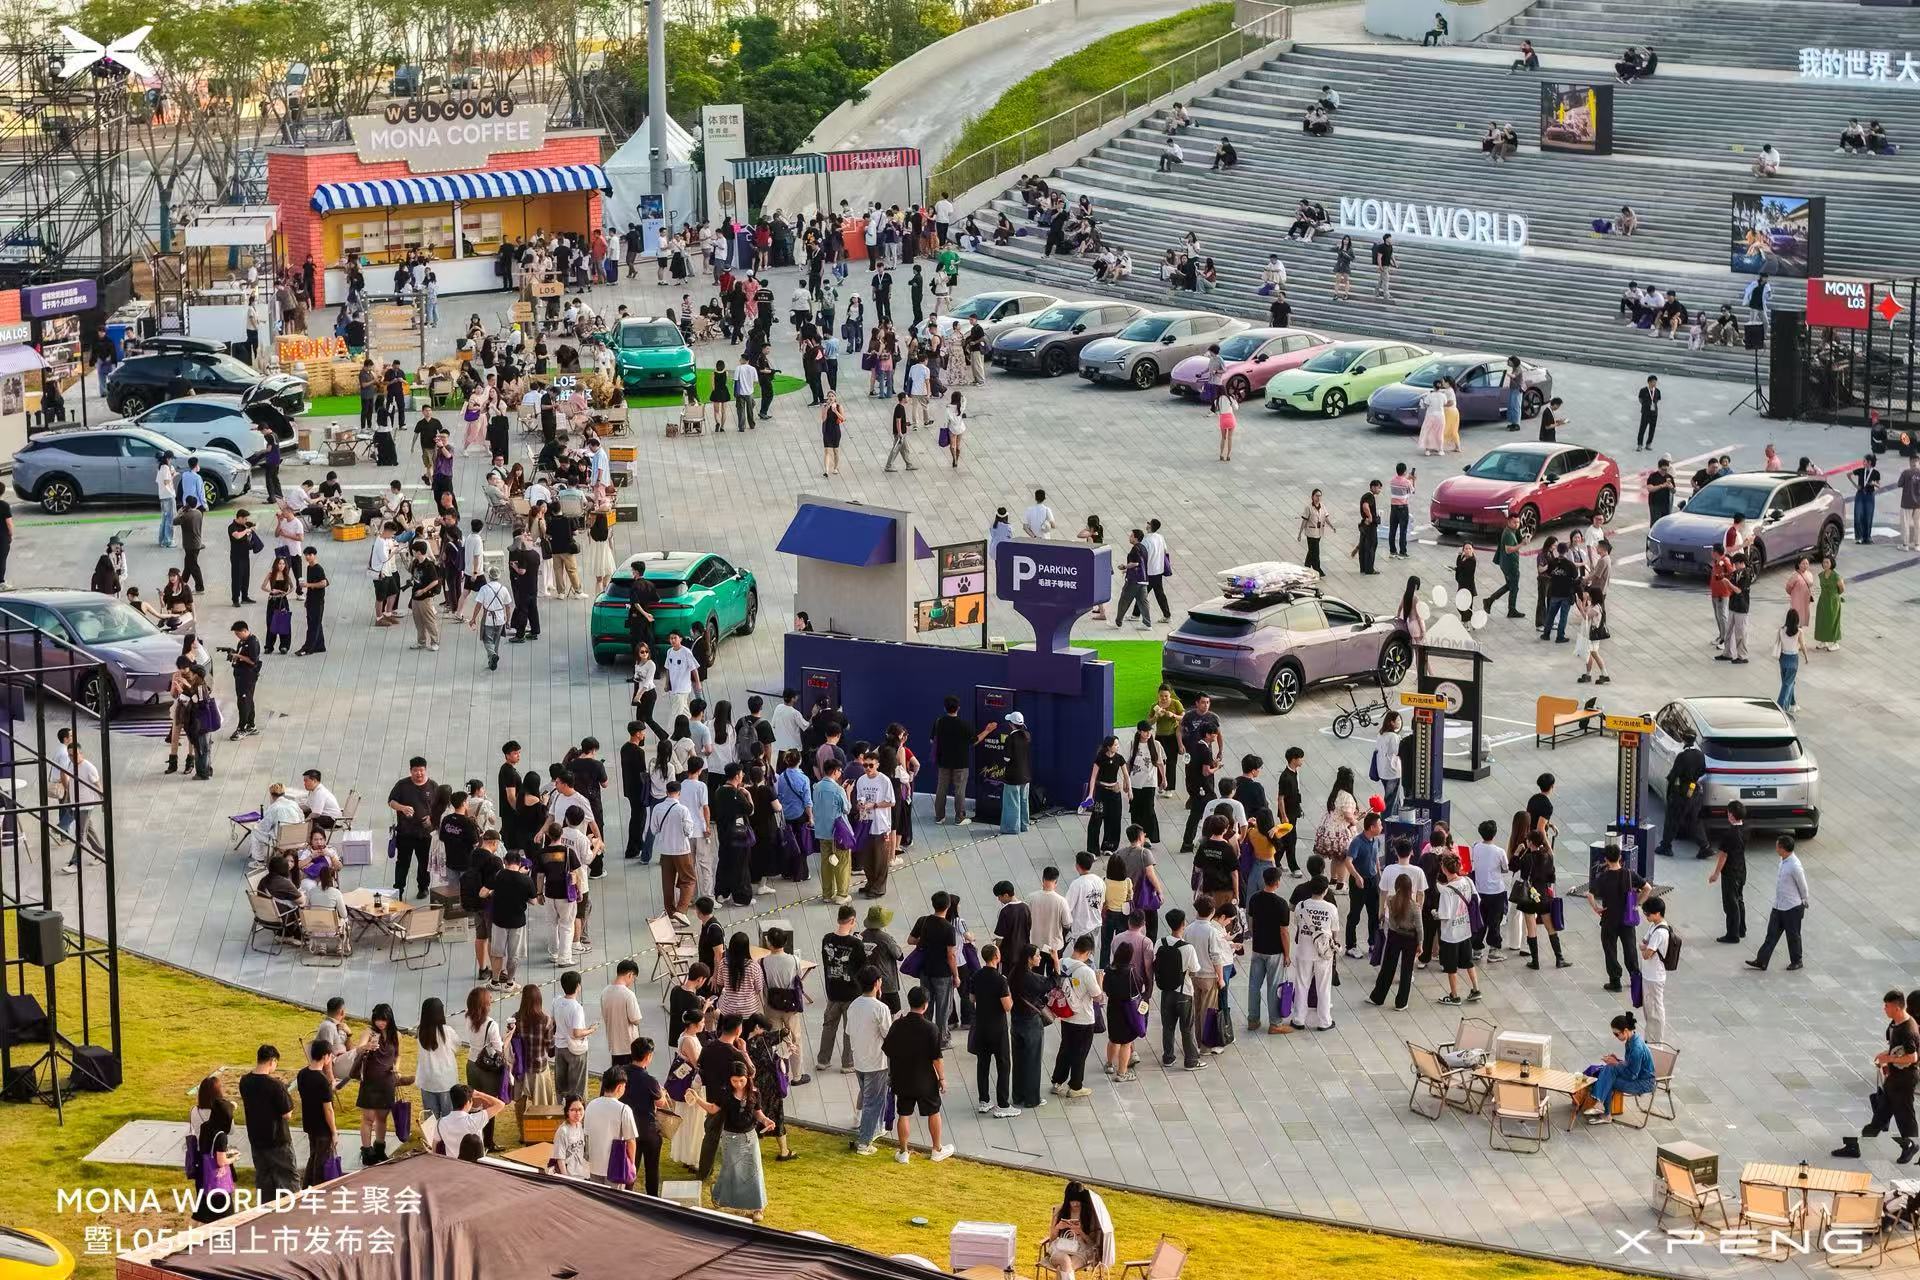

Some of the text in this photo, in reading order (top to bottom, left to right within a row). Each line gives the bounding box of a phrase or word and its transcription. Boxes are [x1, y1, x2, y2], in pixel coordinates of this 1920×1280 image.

[386, 99, 511, 122] WELCOME
[371, 120, 531, 150] MONA COFFEE
[1340, 196, 1528, 248] MONA WORLD
[1825, 281, 1866, 298] MONA
[1847, 297, 1866, 310] L03
[14, 327, 28, 340] L05
[280, 336, 349, 361] MONA
[553, 376, 577, 387] L05
[1012, 555, 1078, 591] P PARKING
